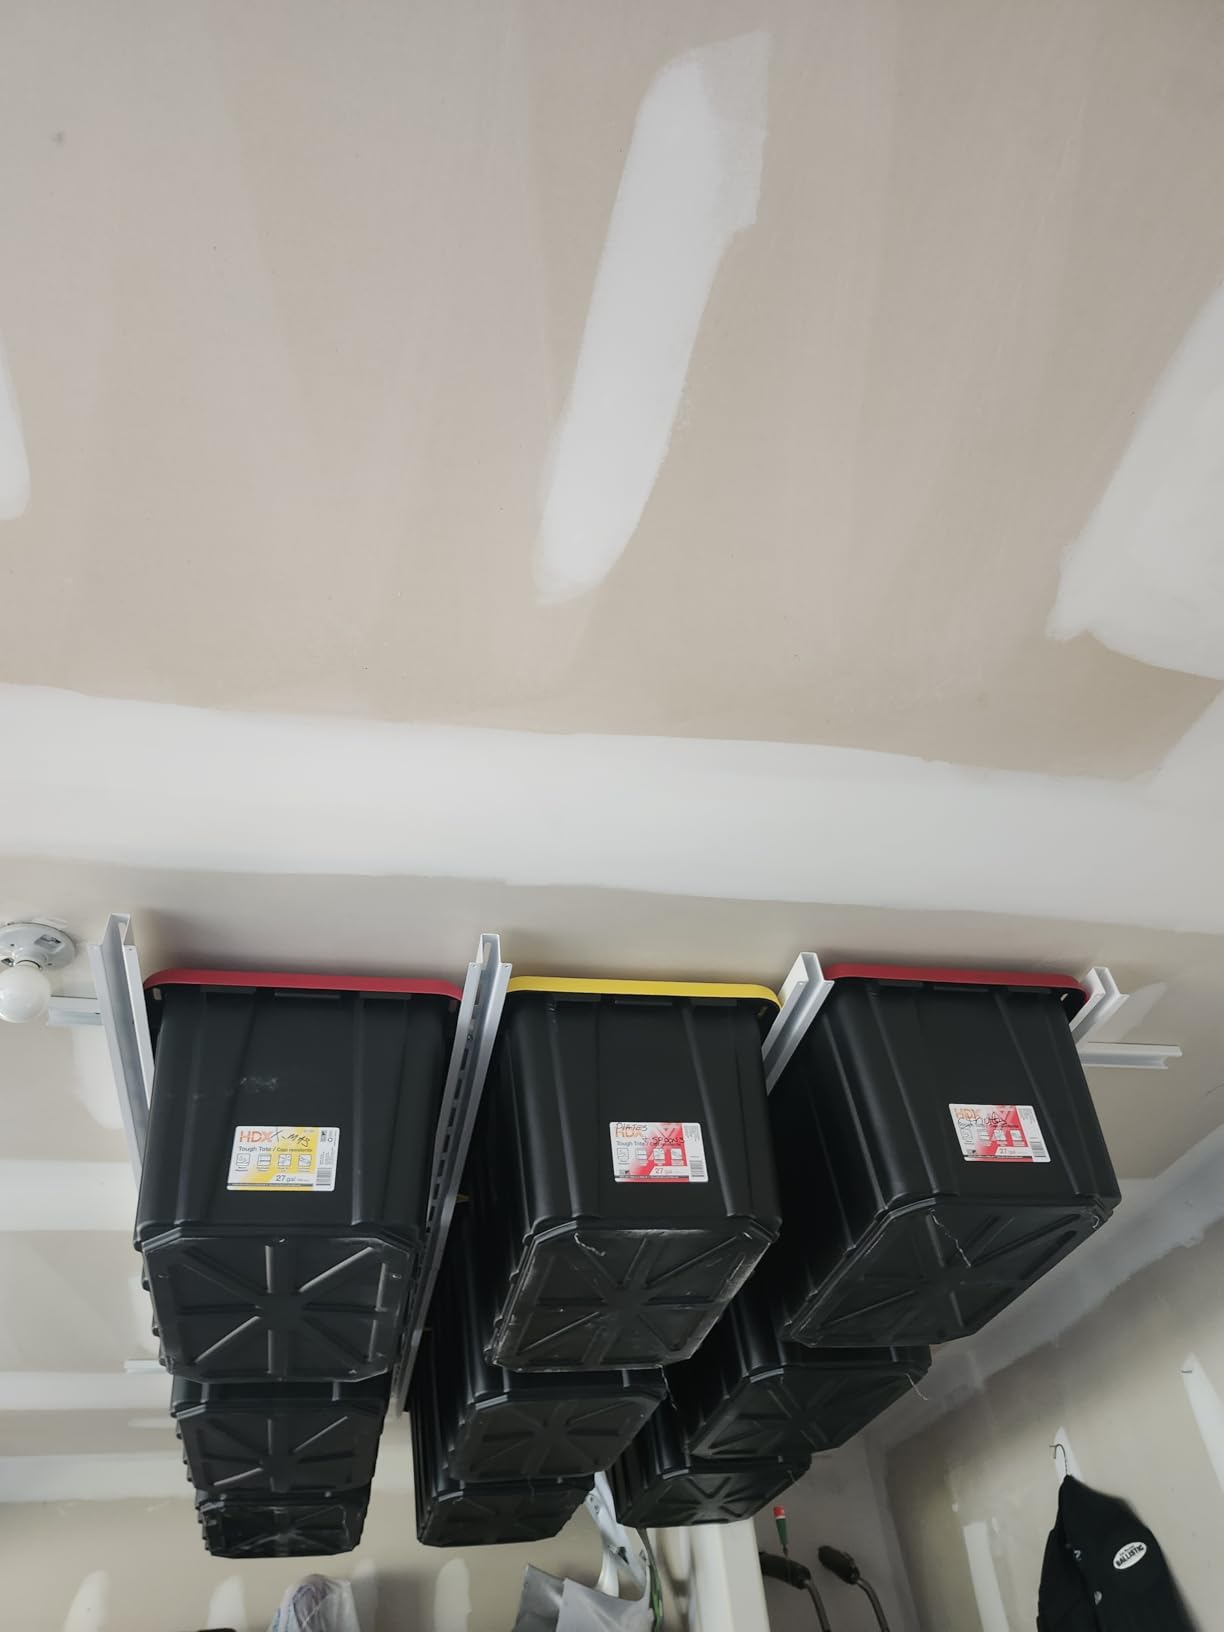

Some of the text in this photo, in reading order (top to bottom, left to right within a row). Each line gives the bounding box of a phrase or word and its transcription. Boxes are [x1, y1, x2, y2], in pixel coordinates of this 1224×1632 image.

[239, 1129, 273, 1143] HDX
[239, 1145, 257, 1153] Tough
[275, 1174, 286, 1182] 27
